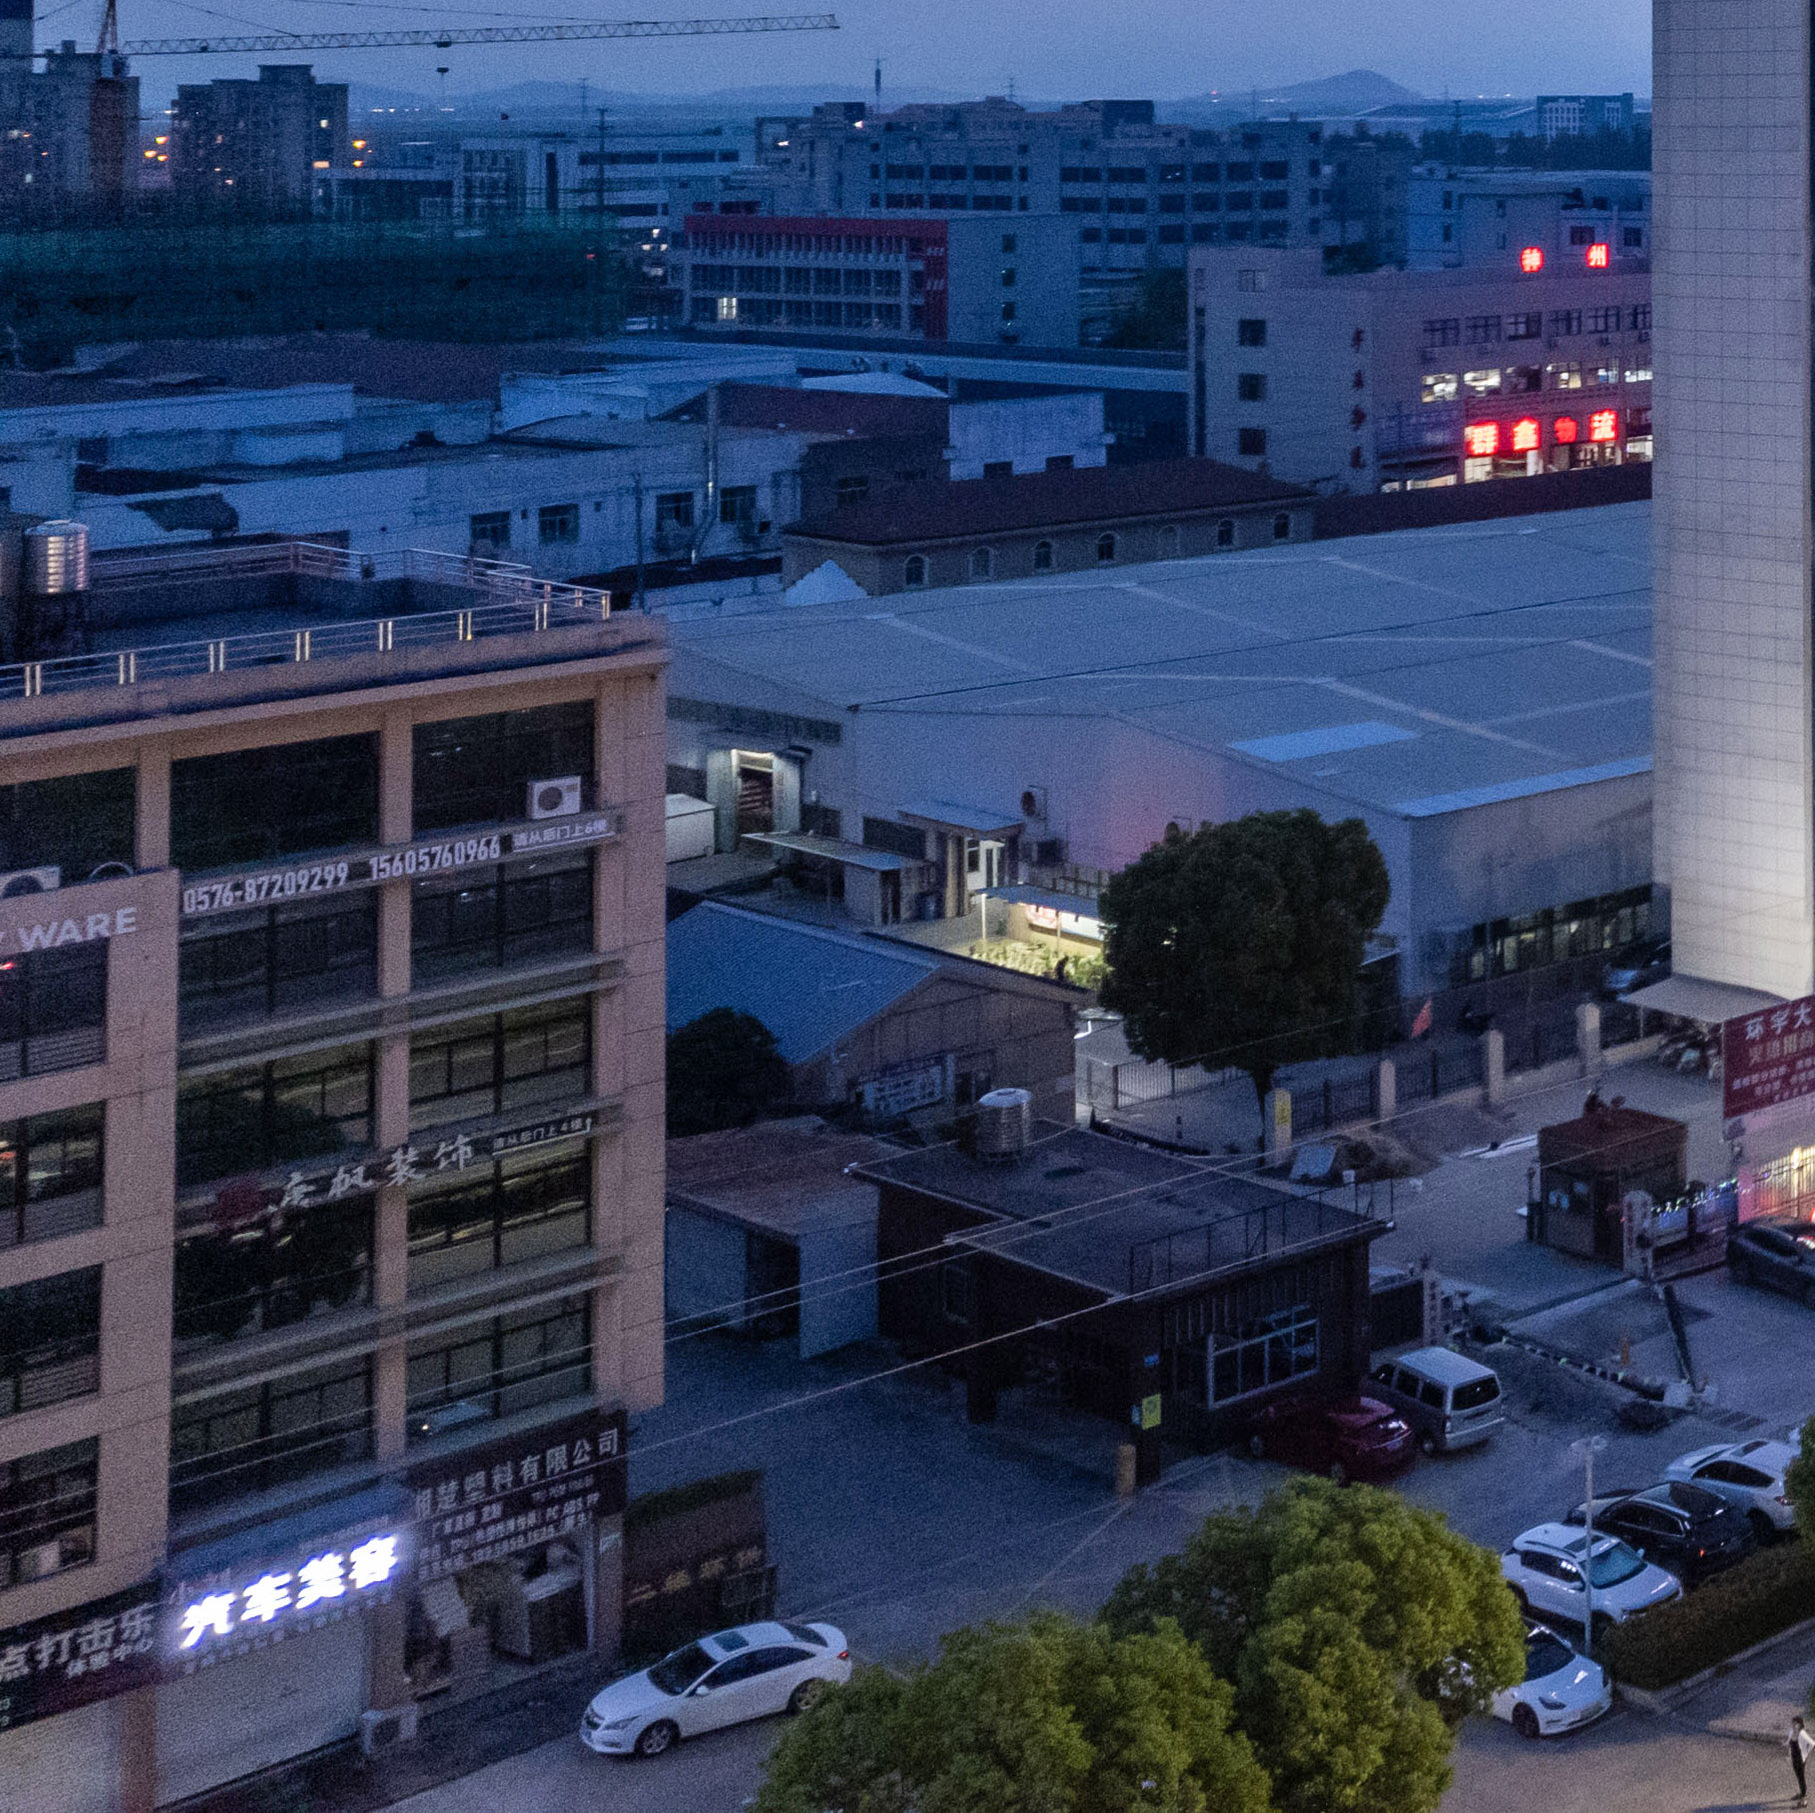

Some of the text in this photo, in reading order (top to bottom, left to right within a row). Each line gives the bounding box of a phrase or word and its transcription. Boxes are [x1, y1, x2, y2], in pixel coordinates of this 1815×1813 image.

[184, 835, 500, 915] 0576-87209299 15605760966
[19, 906, 137, 952] WARE
[180, 1534, 399, 1650] 汽车美容
